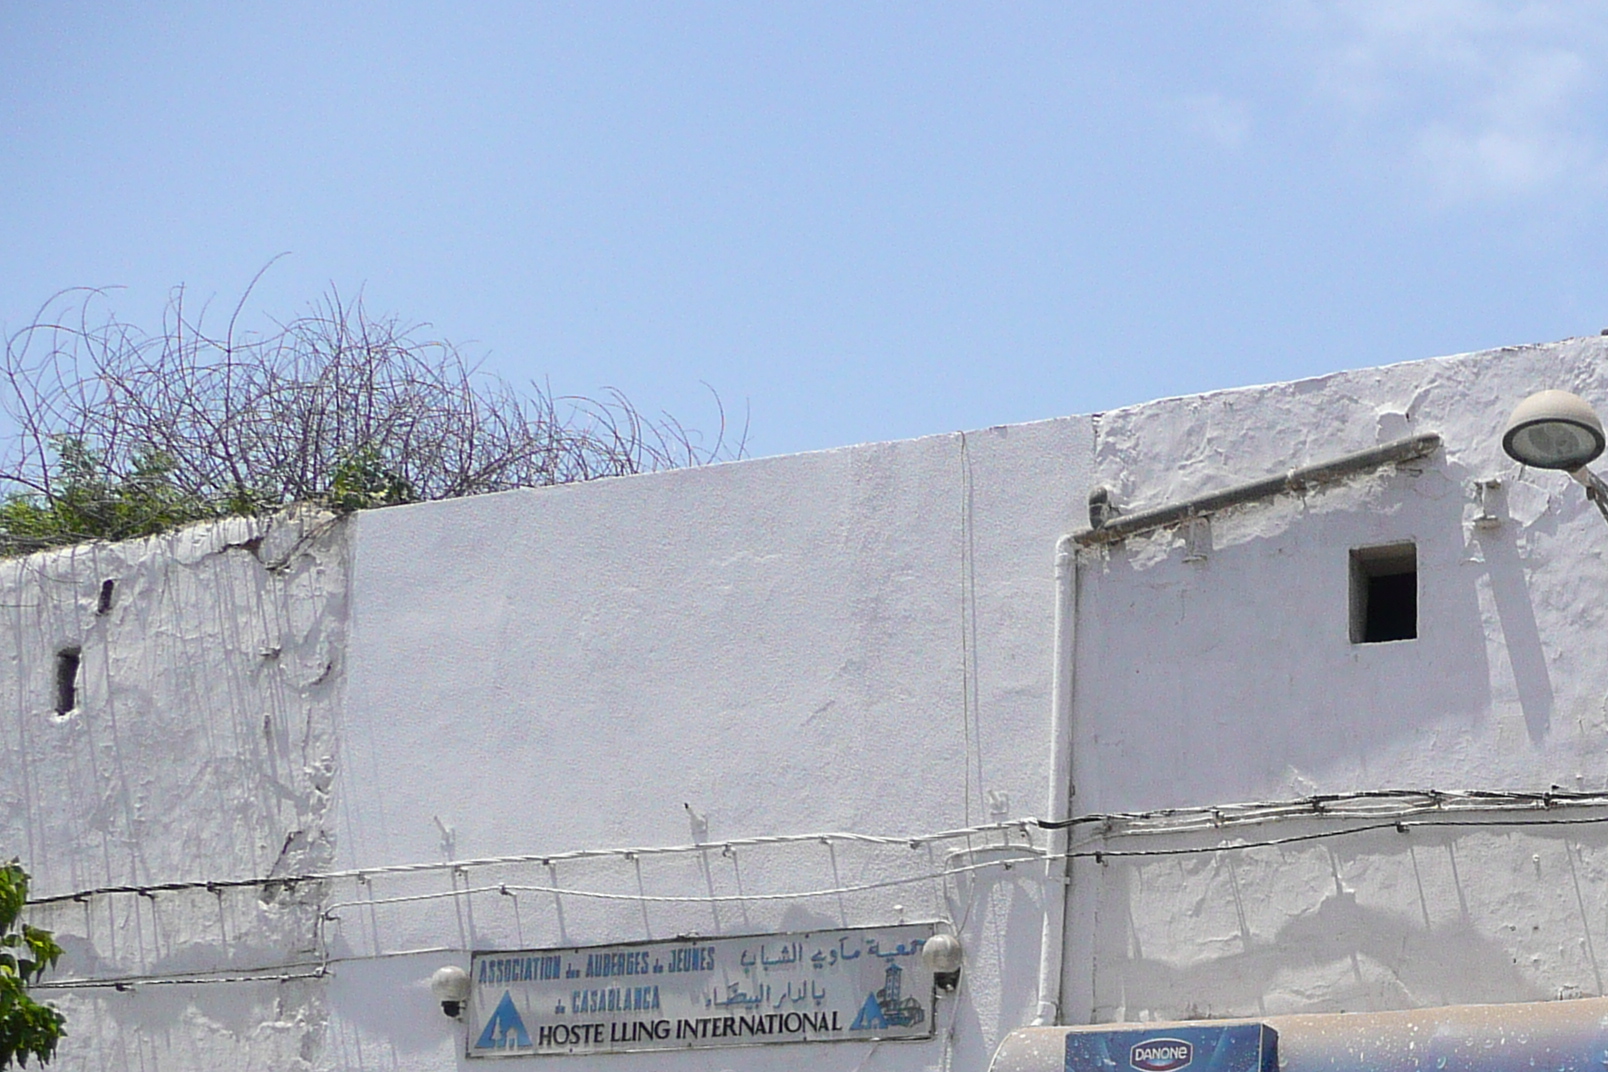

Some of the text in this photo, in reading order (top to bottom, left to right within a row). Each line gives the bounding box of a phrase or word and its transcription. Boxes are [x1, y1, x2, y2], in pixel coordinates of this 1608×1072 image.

[479, 954, 562, 984] ASSOCIATION
[586, 950, 650, 978] AUBERGES
[668, 946, 716, 973] JEUNES
[740, 941, 803, 974] الشباب
[572, 985, 661, 1014] CASABLANCA
[704, 979, 827, 1010] بالدار البيضاء
[676, 1011, 843, 1040] INTERNATIONAL
